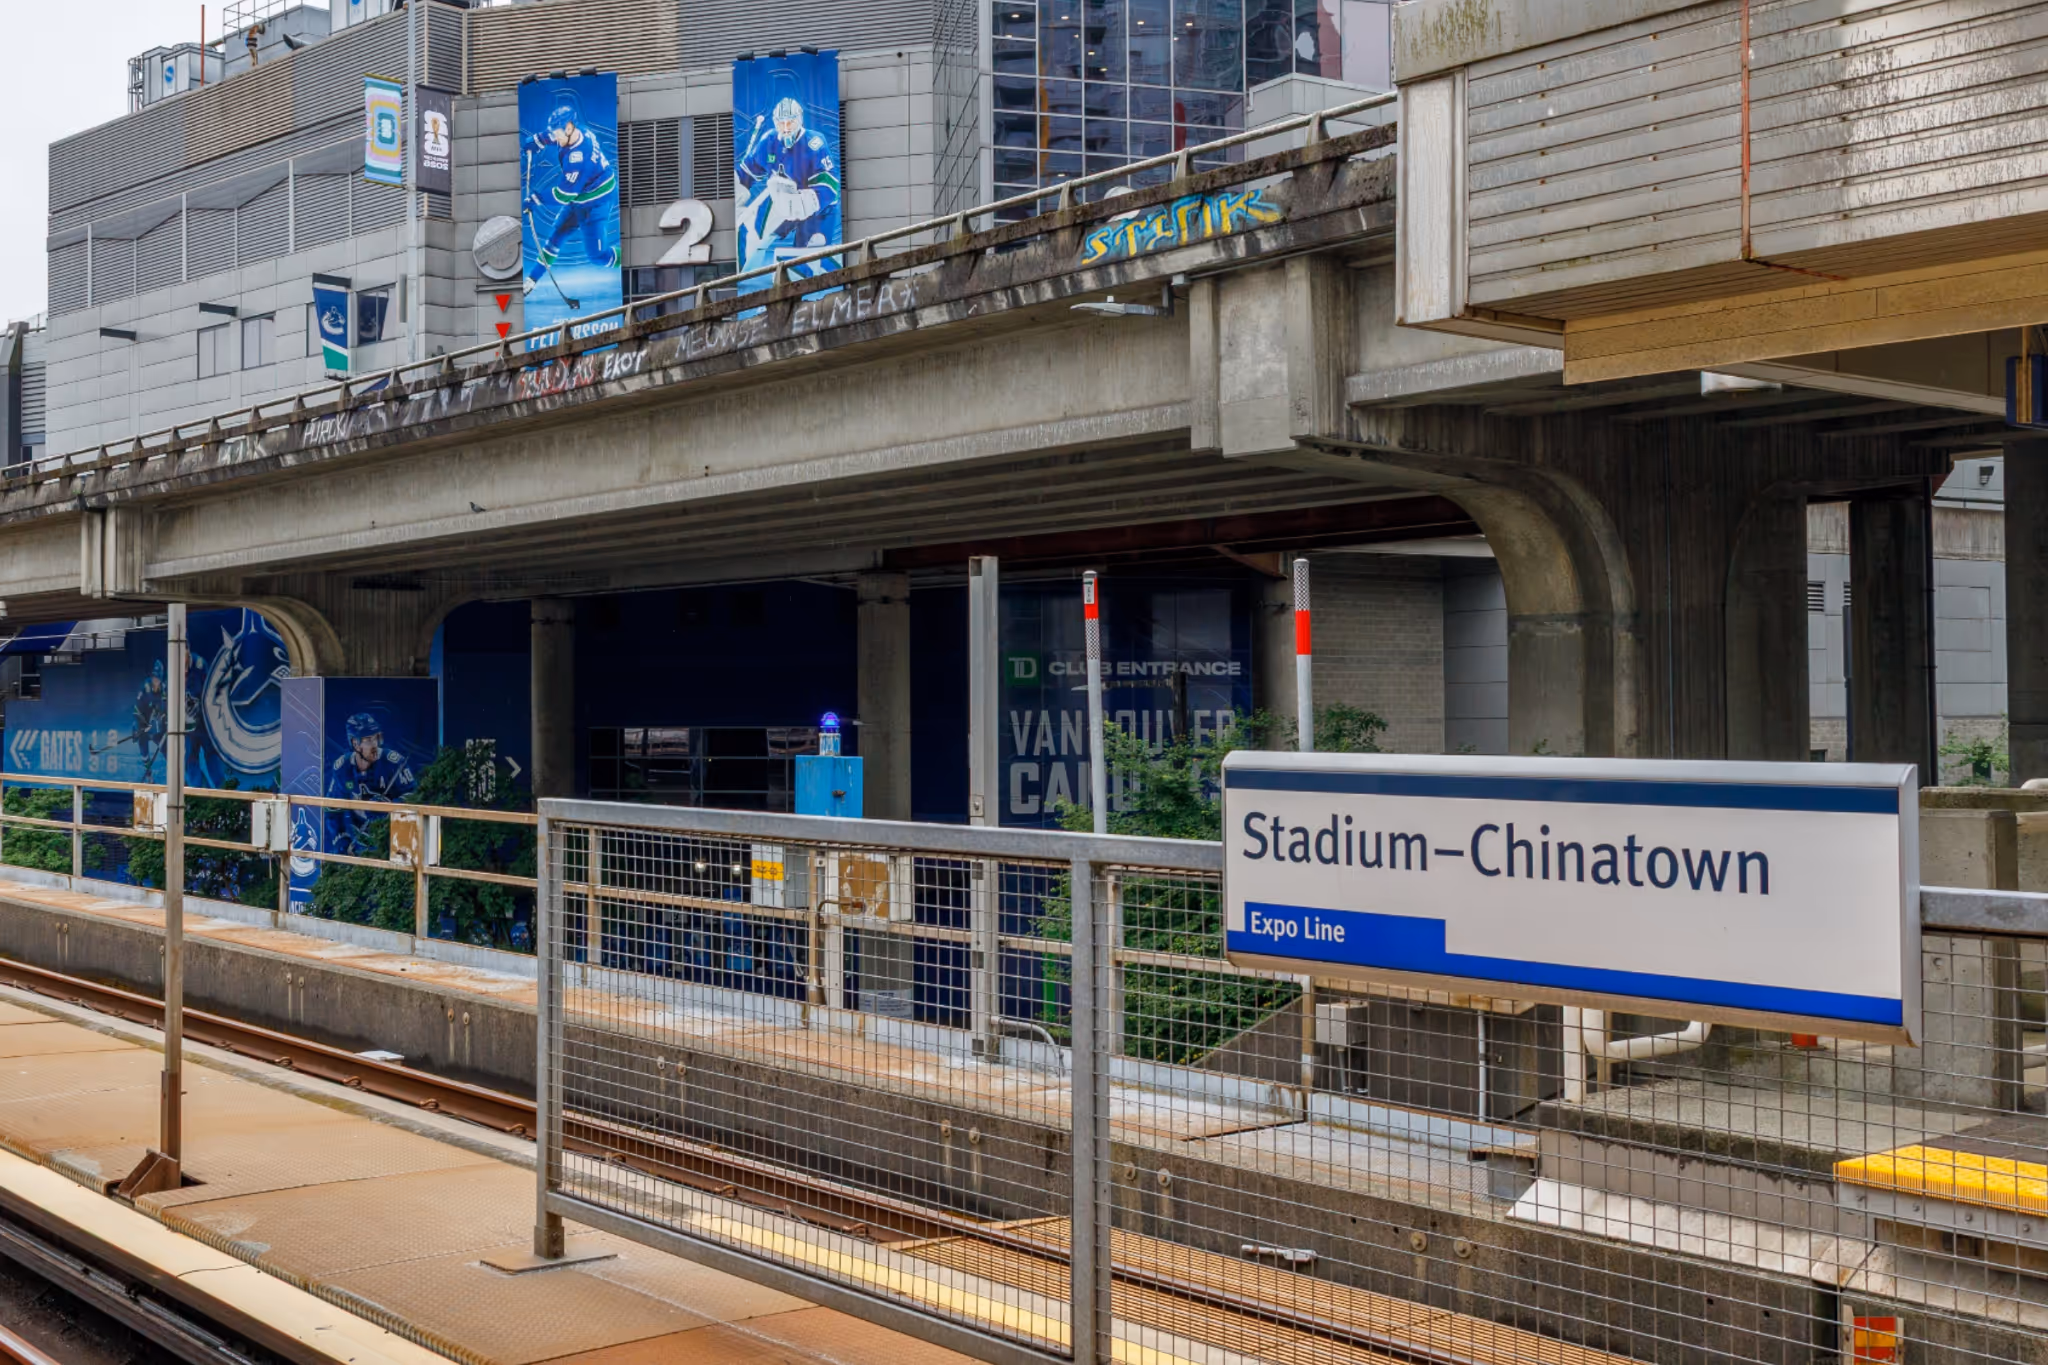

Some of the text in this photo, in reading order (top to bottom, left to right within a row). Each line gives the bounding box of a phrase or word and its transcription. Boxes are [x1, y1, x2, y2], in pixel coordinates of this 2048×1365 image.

[655, 199, 714, 266] 2
[1008, 657, 1037, 679] TD
[1117, 661, 1241, 676] ENTRANCE
[40, 730, 82, 771] GATES
[1251, 911, 1345, 942] Expo Line
